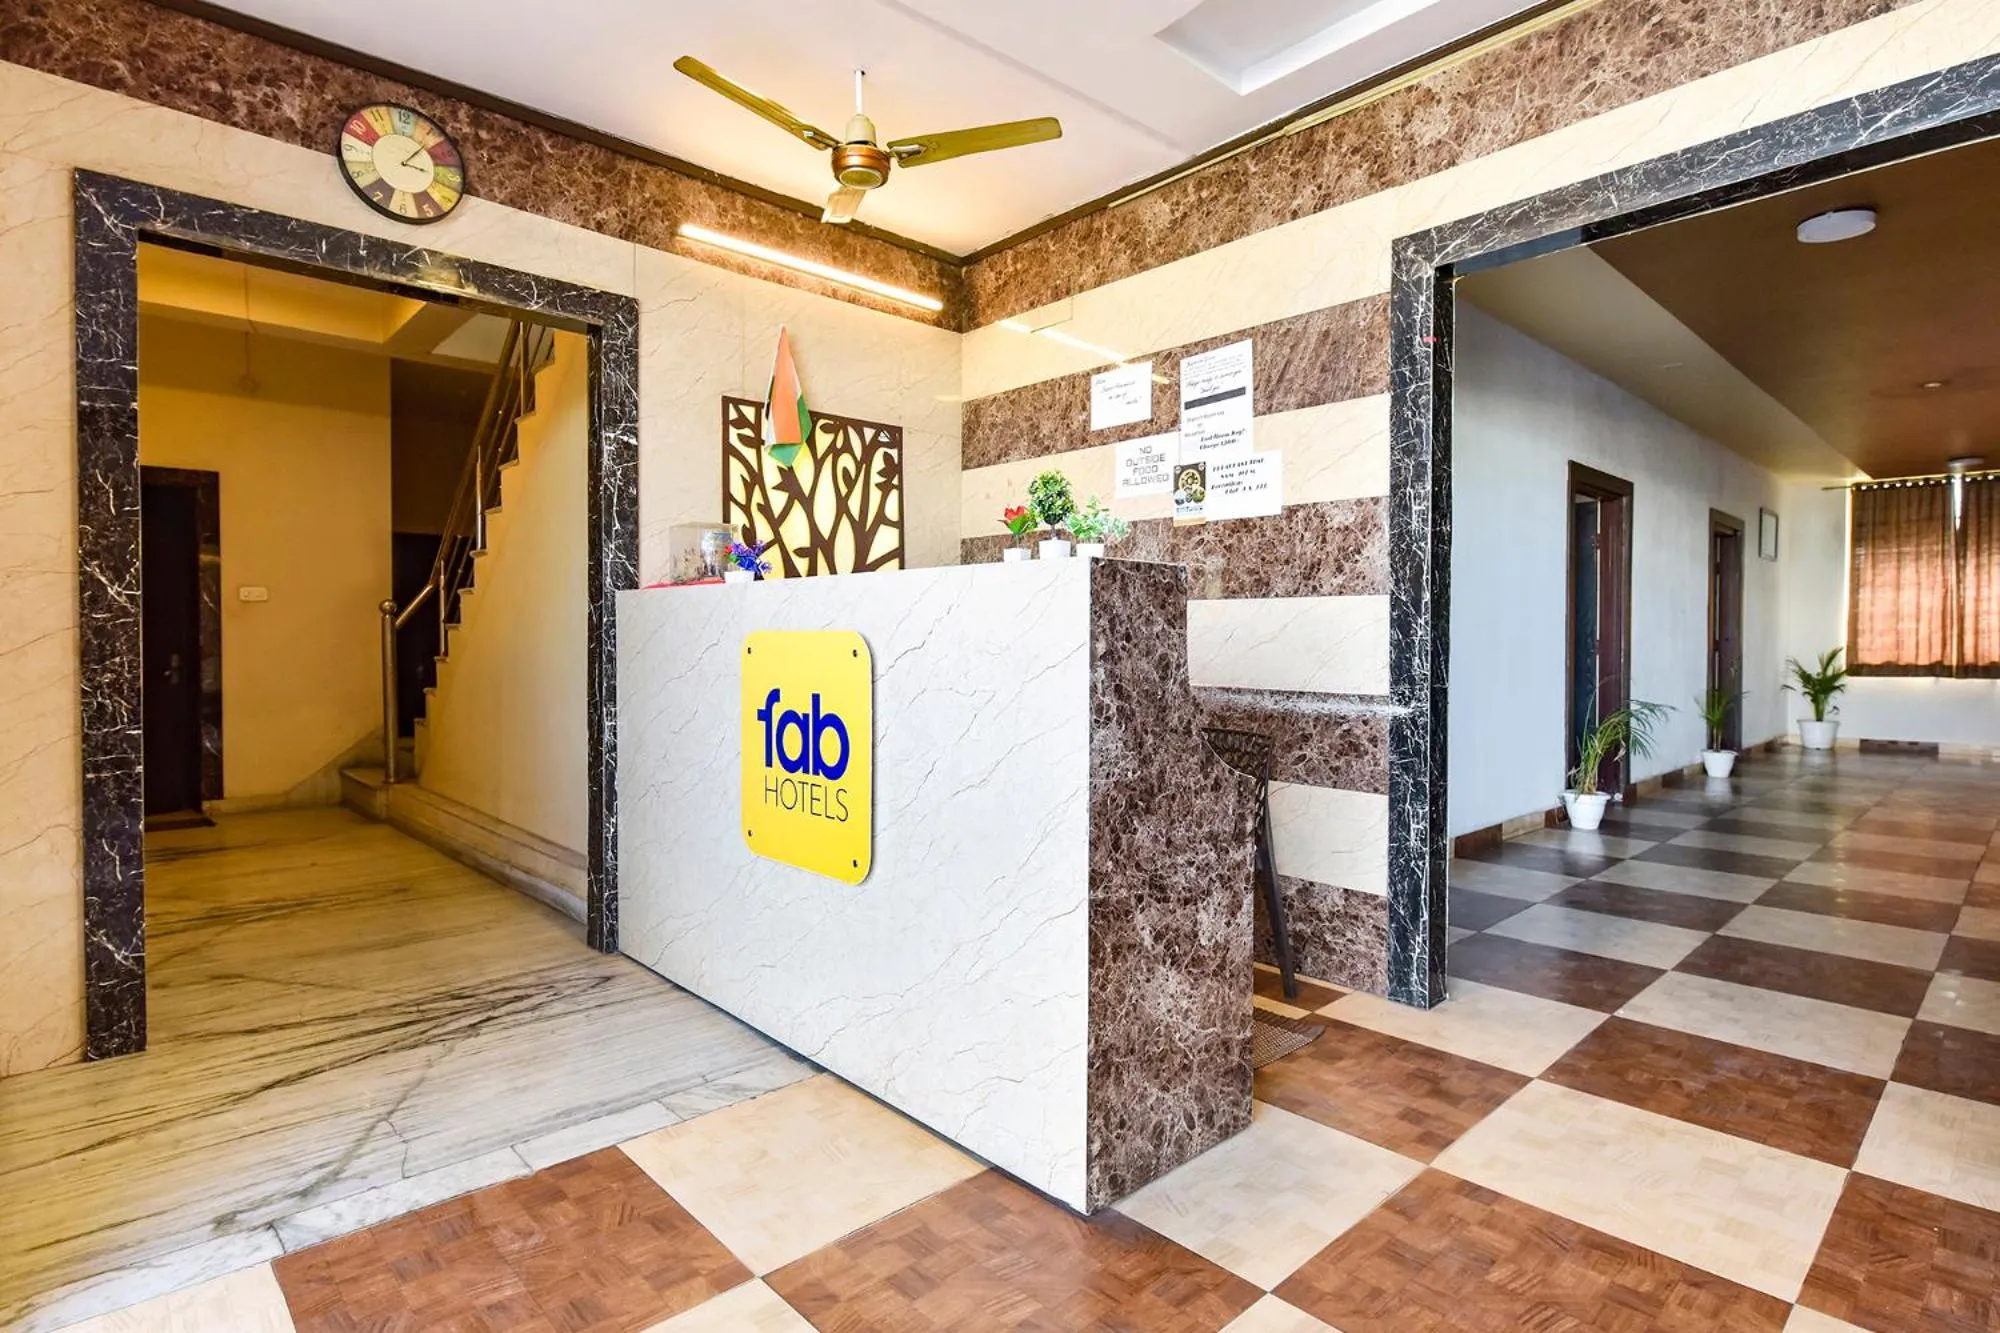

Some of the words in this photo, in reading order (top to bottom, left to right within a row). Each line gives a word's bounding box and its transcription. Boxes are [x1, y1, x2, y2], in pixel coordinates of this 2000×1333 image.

[370, 110, 384, 122] 11
[398, 111, 411, 125] 12
[350, 120, 367, 135] 10
[343, 143, 358, 152] 9
[372, 191, 384, 201] 7
[399, 202, 408, 215] 6
[422, 203, 434, 217] 5
[1139, 446, 1152, 454] NO
[1126, 453, 1166, 467] OUTSIDE
[1132, 464, 1158, 476] FOOD
[1122, 473, 1169, 487] ALLOWED
[757, 688, 850, 781] fab
[764, 774, 849, 822] HOTELS
